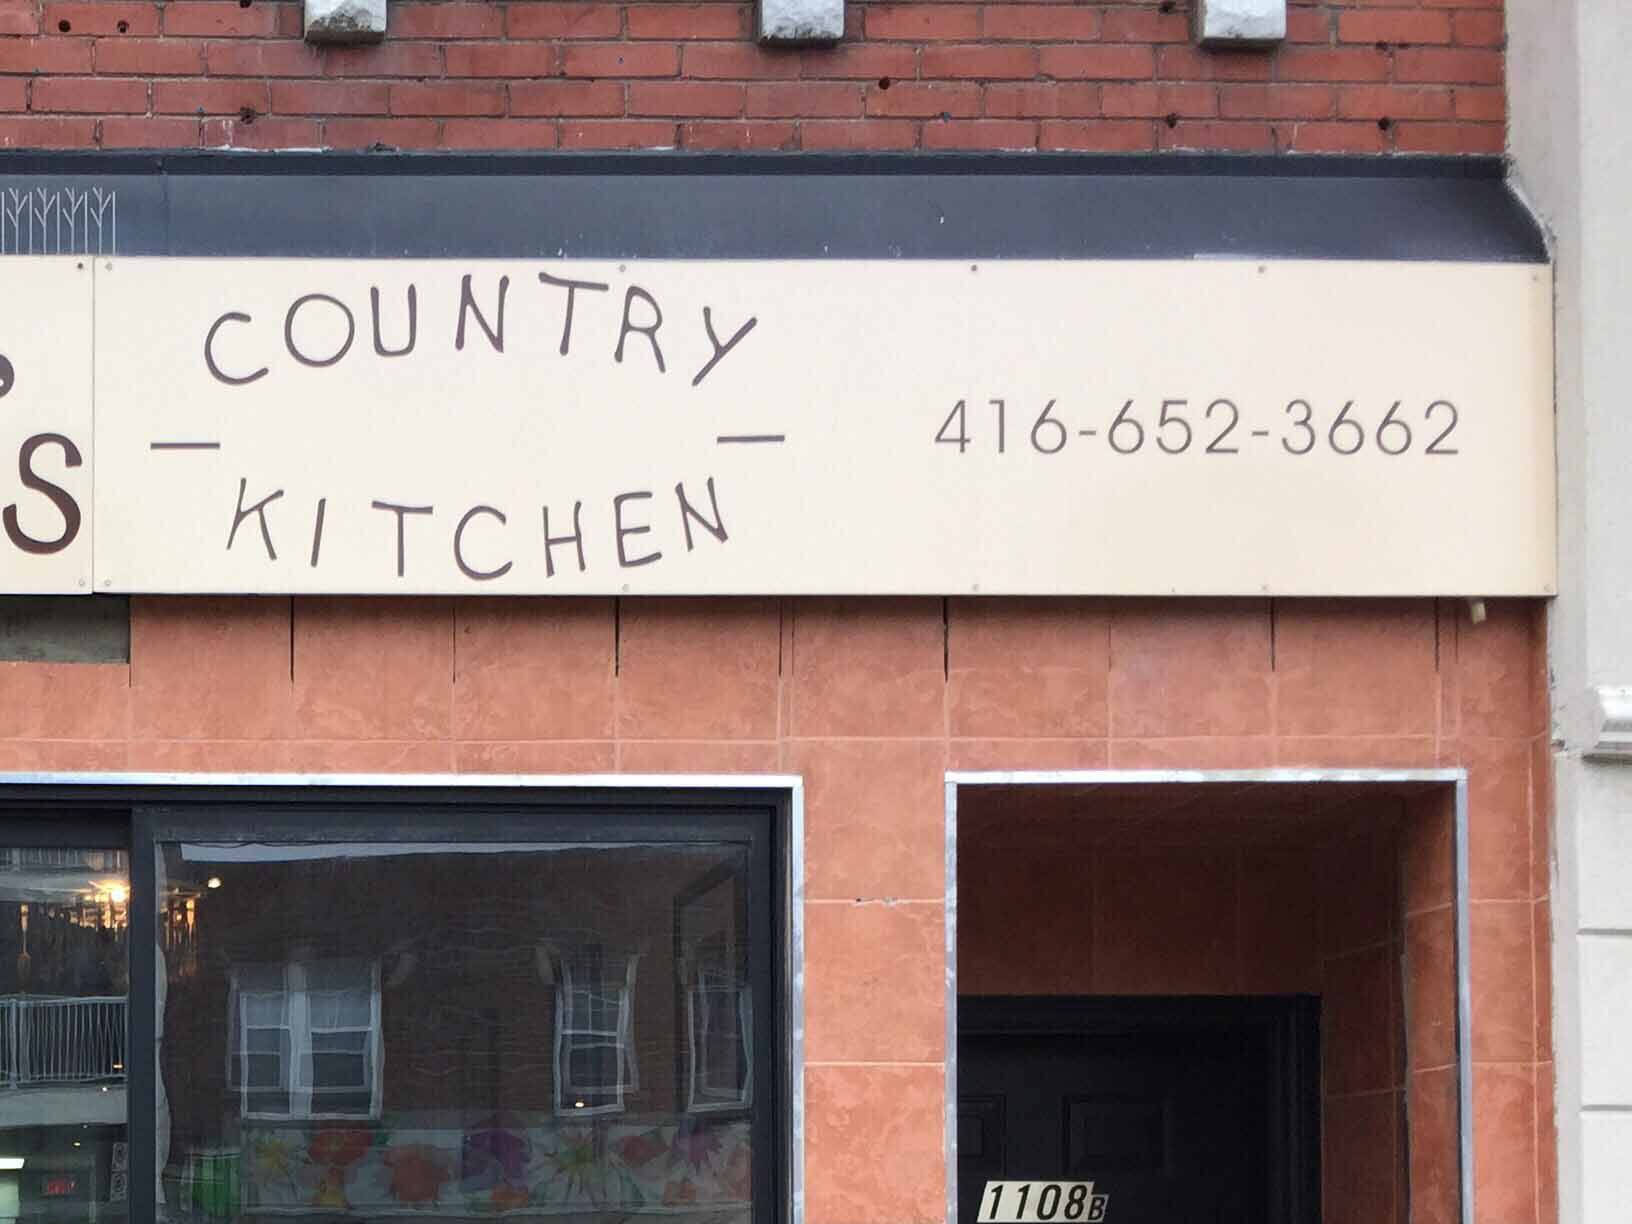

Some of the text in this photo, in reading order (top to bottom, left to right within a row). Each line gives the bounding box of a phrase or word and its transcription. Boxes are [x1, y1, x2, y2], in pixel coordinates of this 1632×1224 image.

[205, 272, 757, 386] COUNTRY
[934, 398, 1460, 456] 416-652-3662
[227, 477, 729, 580] KITCHEN
